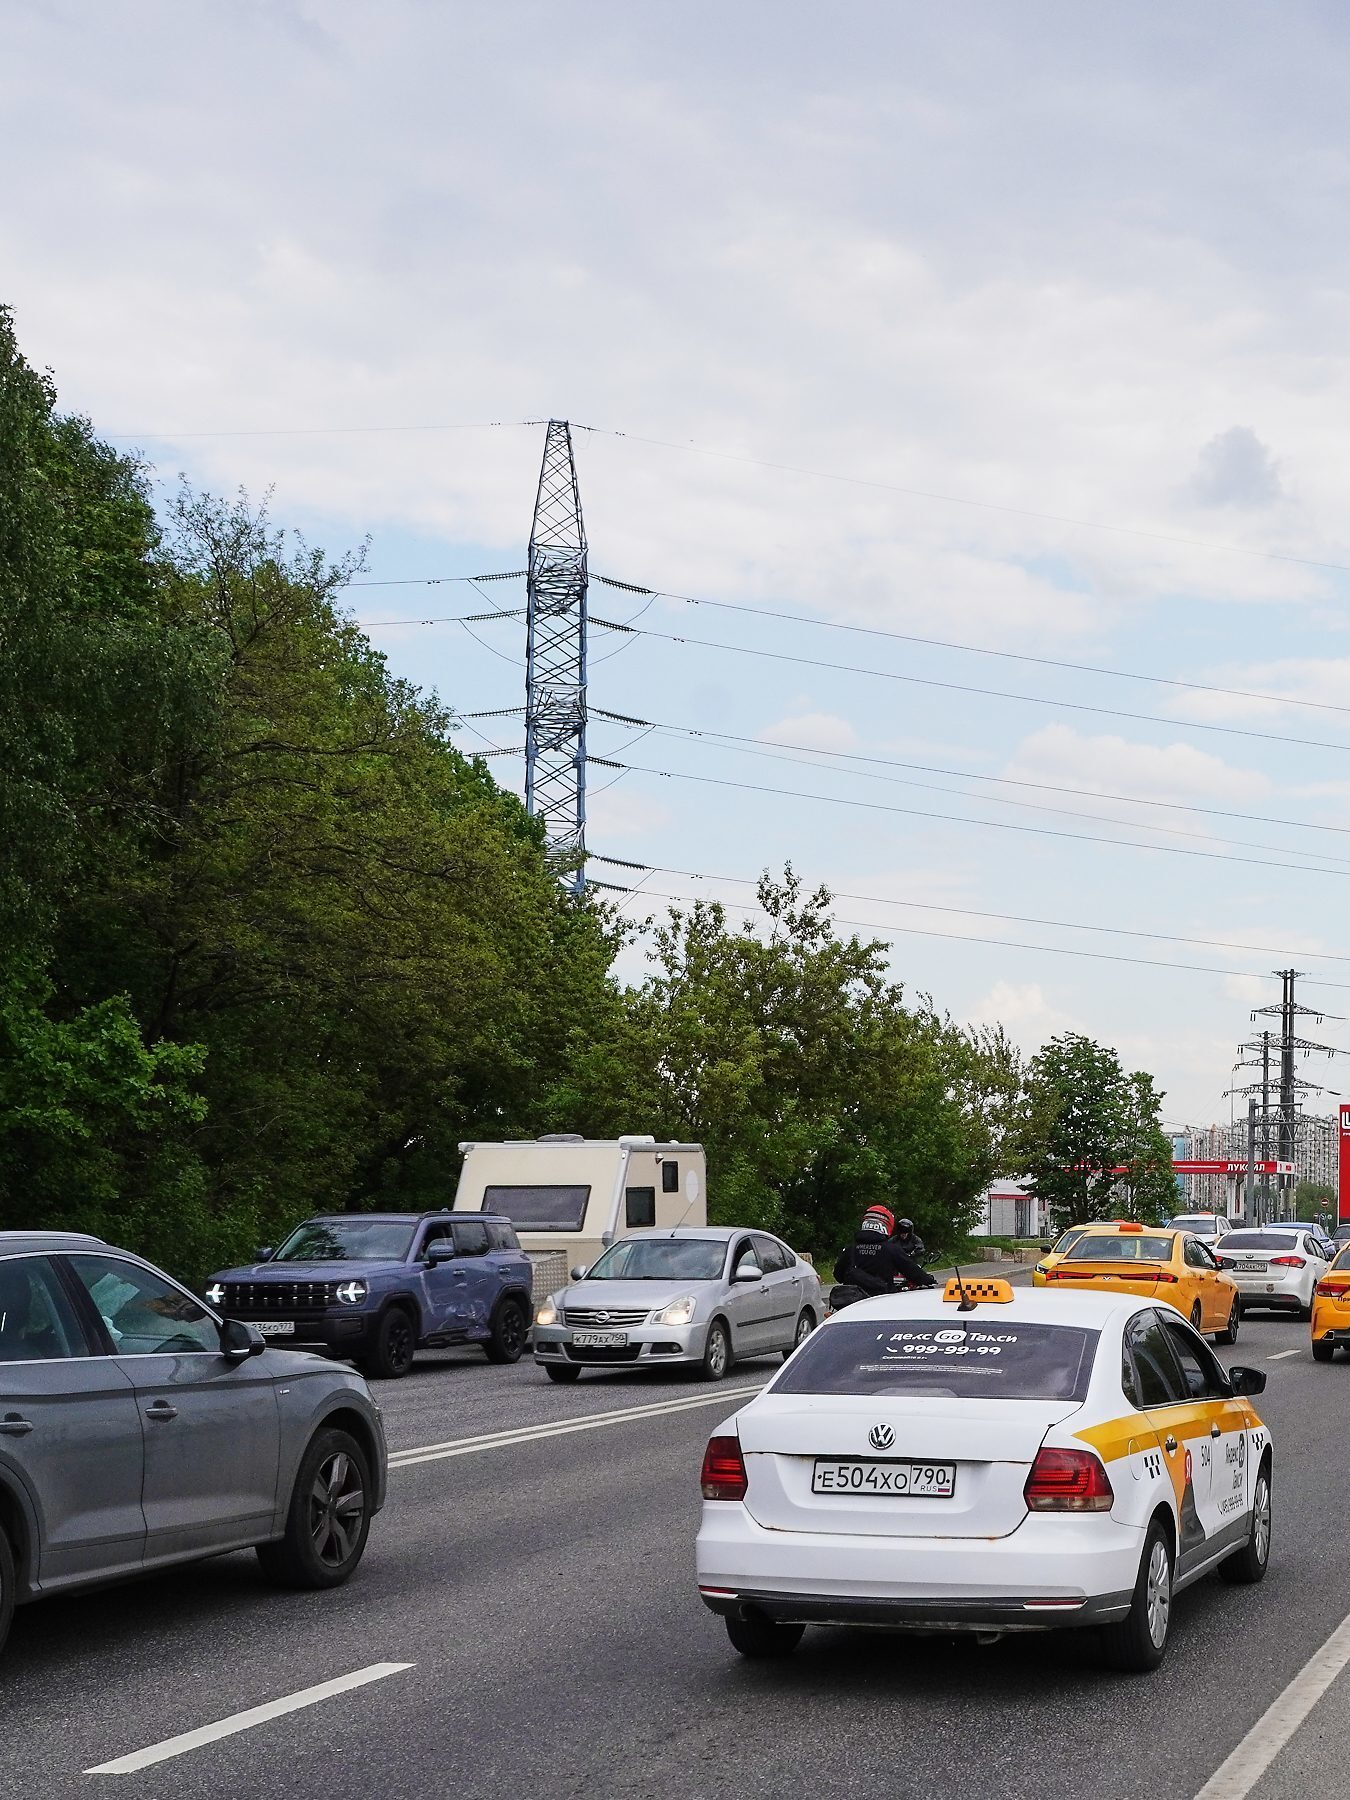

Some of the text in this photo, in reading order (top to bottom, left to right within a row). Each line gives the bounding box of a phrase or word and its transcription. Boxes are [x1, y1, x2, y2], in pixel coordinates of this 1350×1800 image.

[969, 1332, 1018, 1343] Такси
[902, 1345, 1002, 1355] 999-99-99
[912, 1467, 947, 1485] 790
